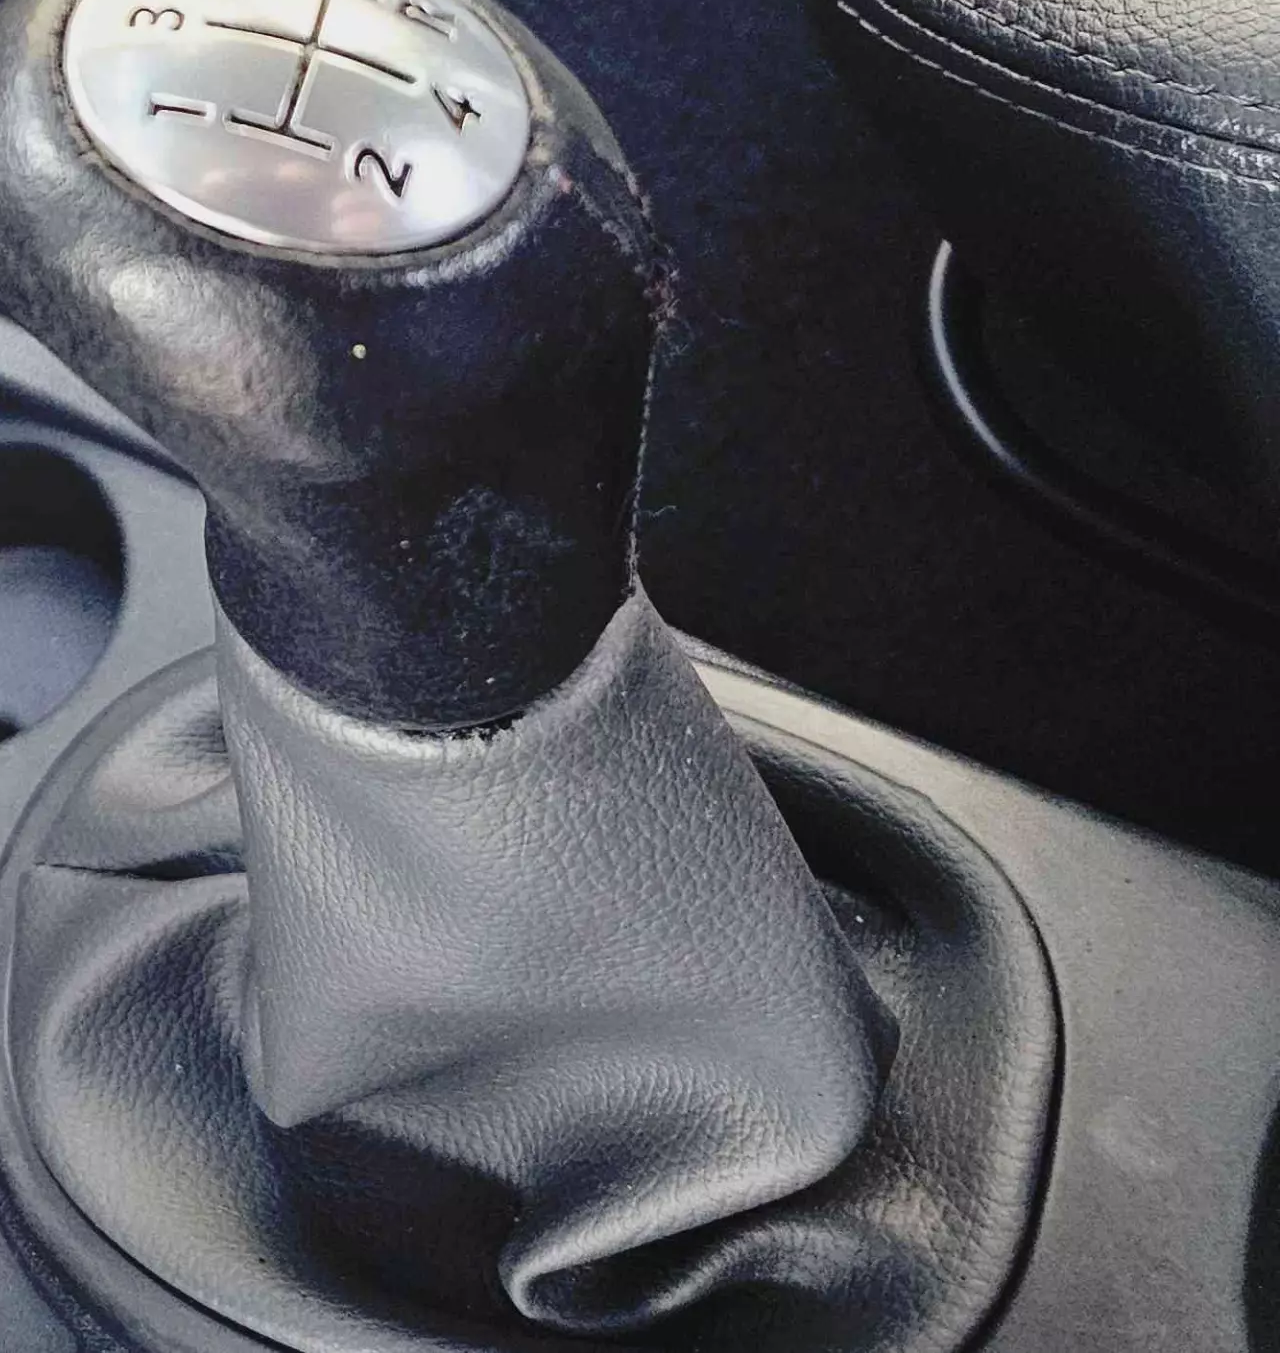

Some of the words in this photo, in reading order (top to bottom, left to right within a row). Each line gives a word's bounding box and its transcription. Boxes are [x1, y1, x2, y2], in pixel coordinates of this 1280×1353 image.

[129, 6, 186, 32] 3
[430, 82, 483, 134] 4
[354, 147, 412, 198] 2
